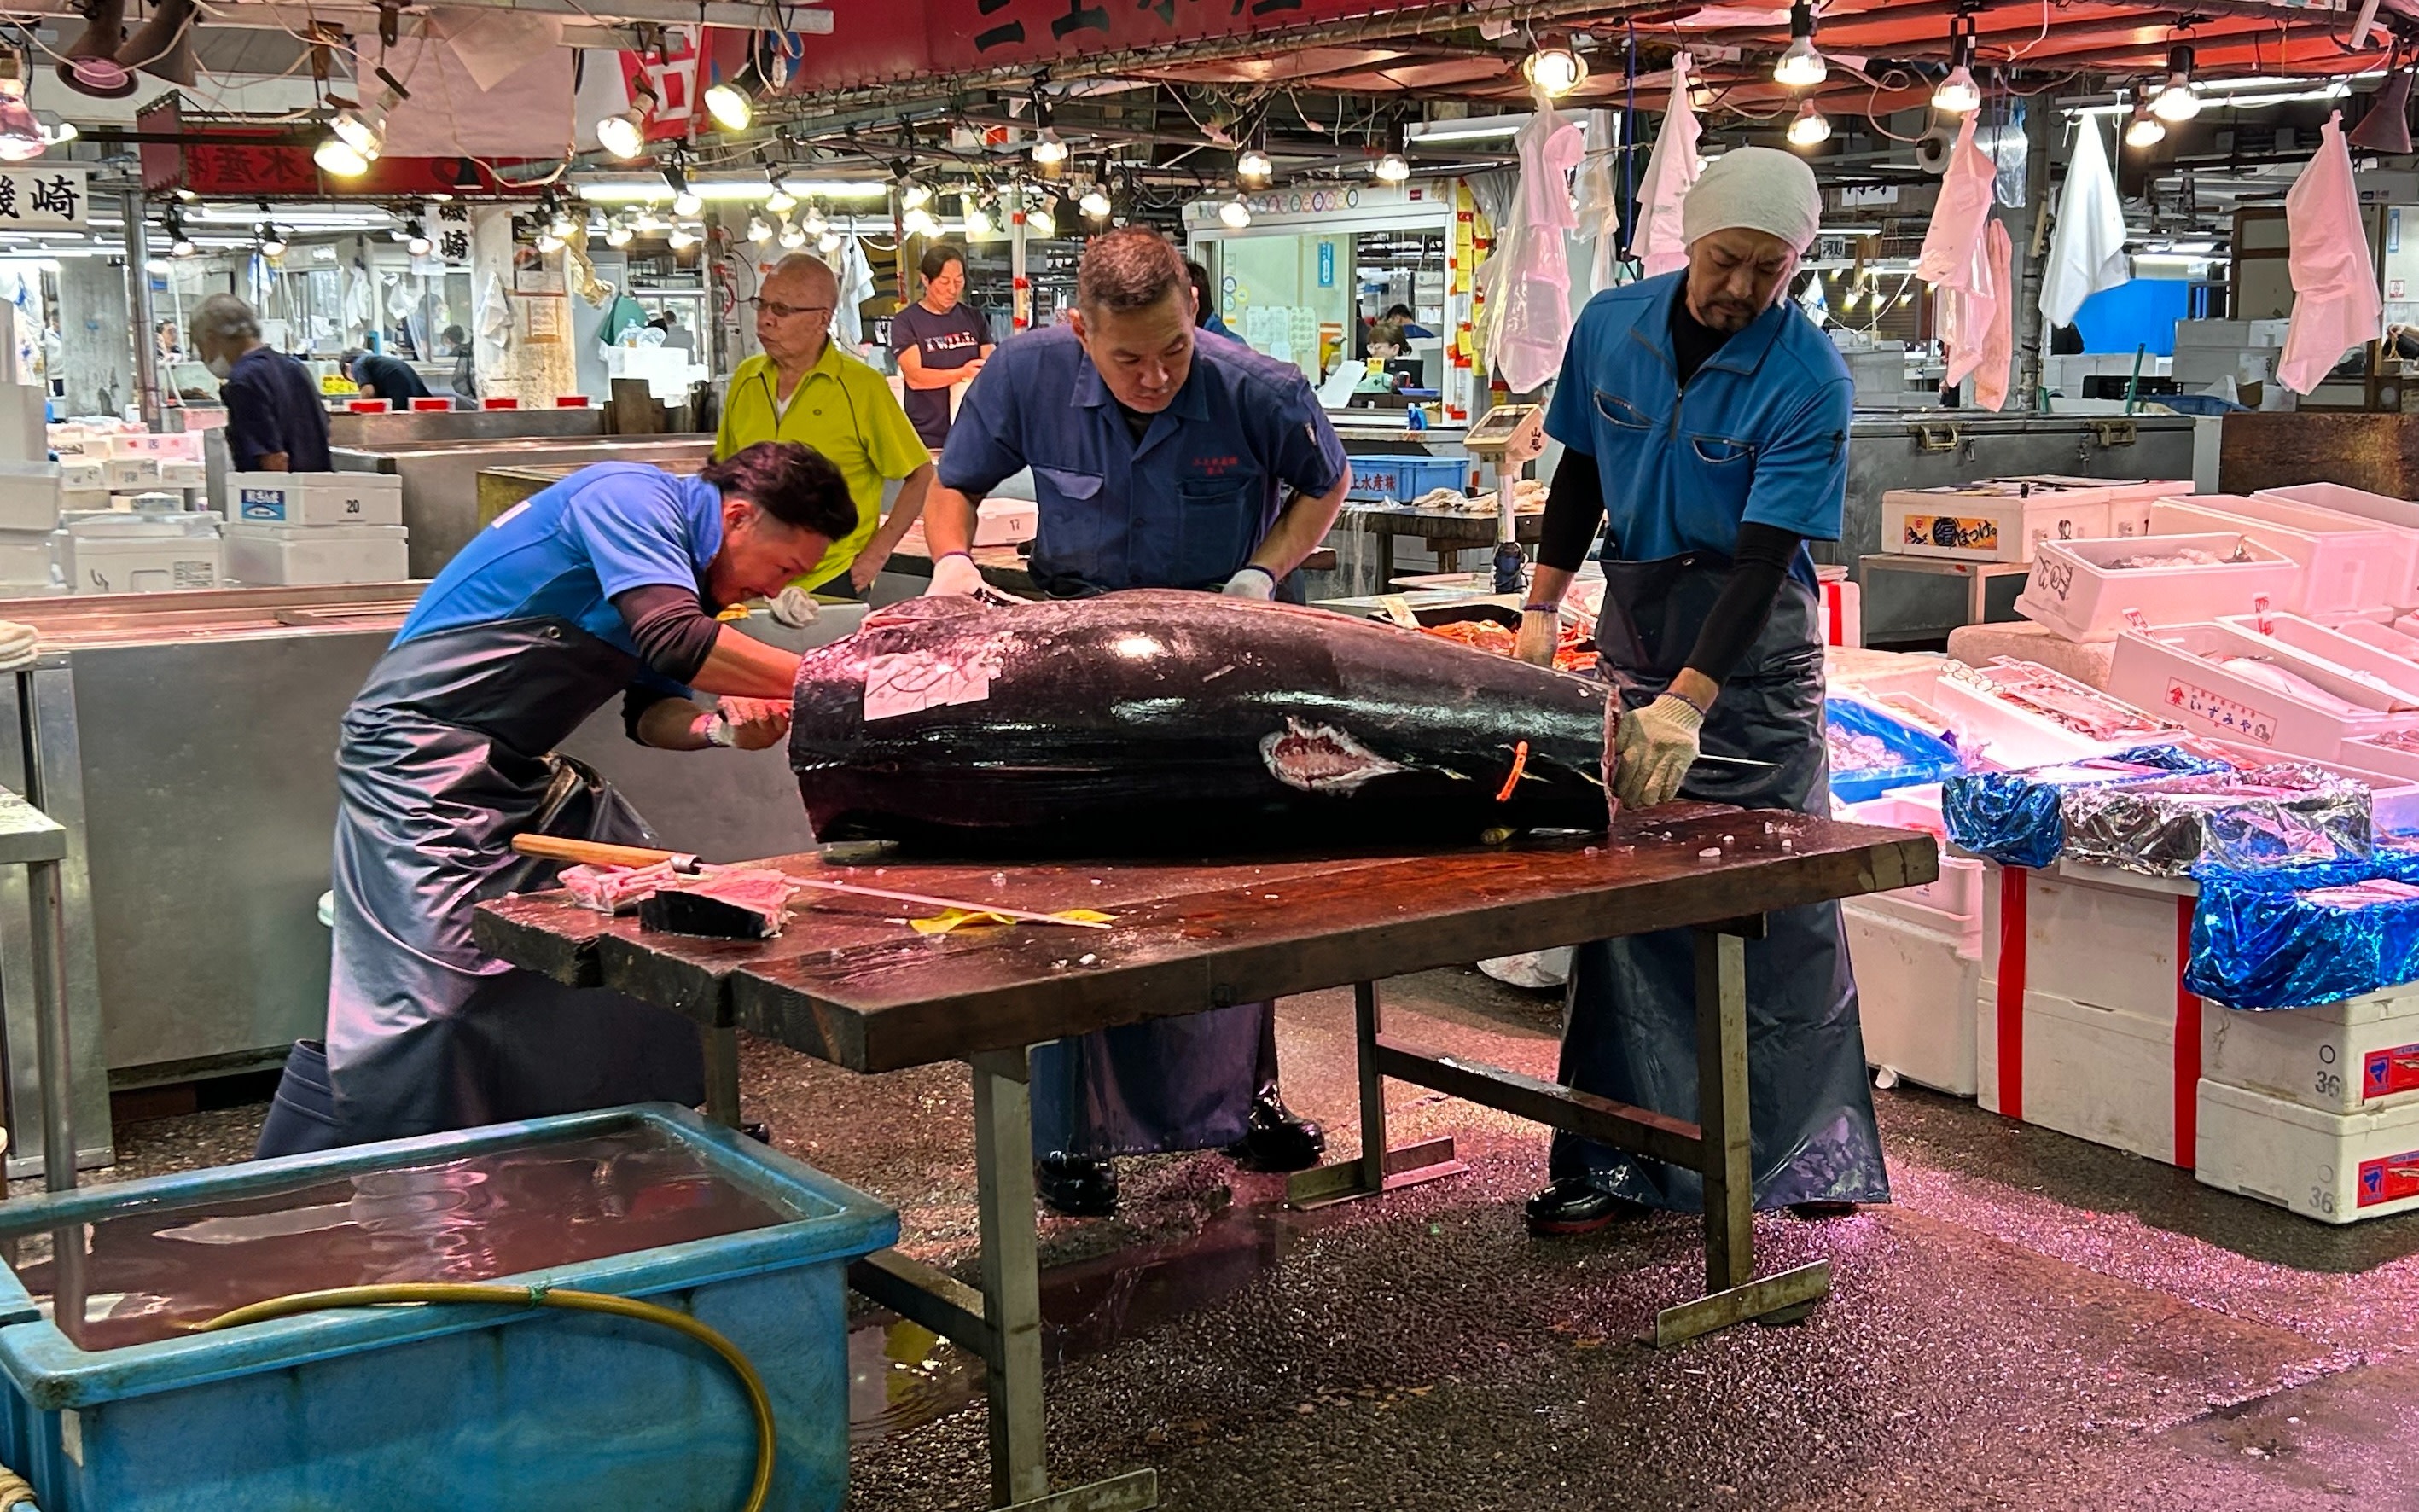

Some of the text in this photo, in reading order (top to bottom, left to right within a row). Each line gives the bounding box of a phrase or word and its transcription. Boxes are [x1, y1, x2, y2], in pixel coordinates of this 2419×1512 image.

[346, 500, 360, 514] 20
[1009, 518, 1020, 531] 17
[2314, 1070, 2340, 1098] 36
[2307, 1185, 2334, 1214] 36
